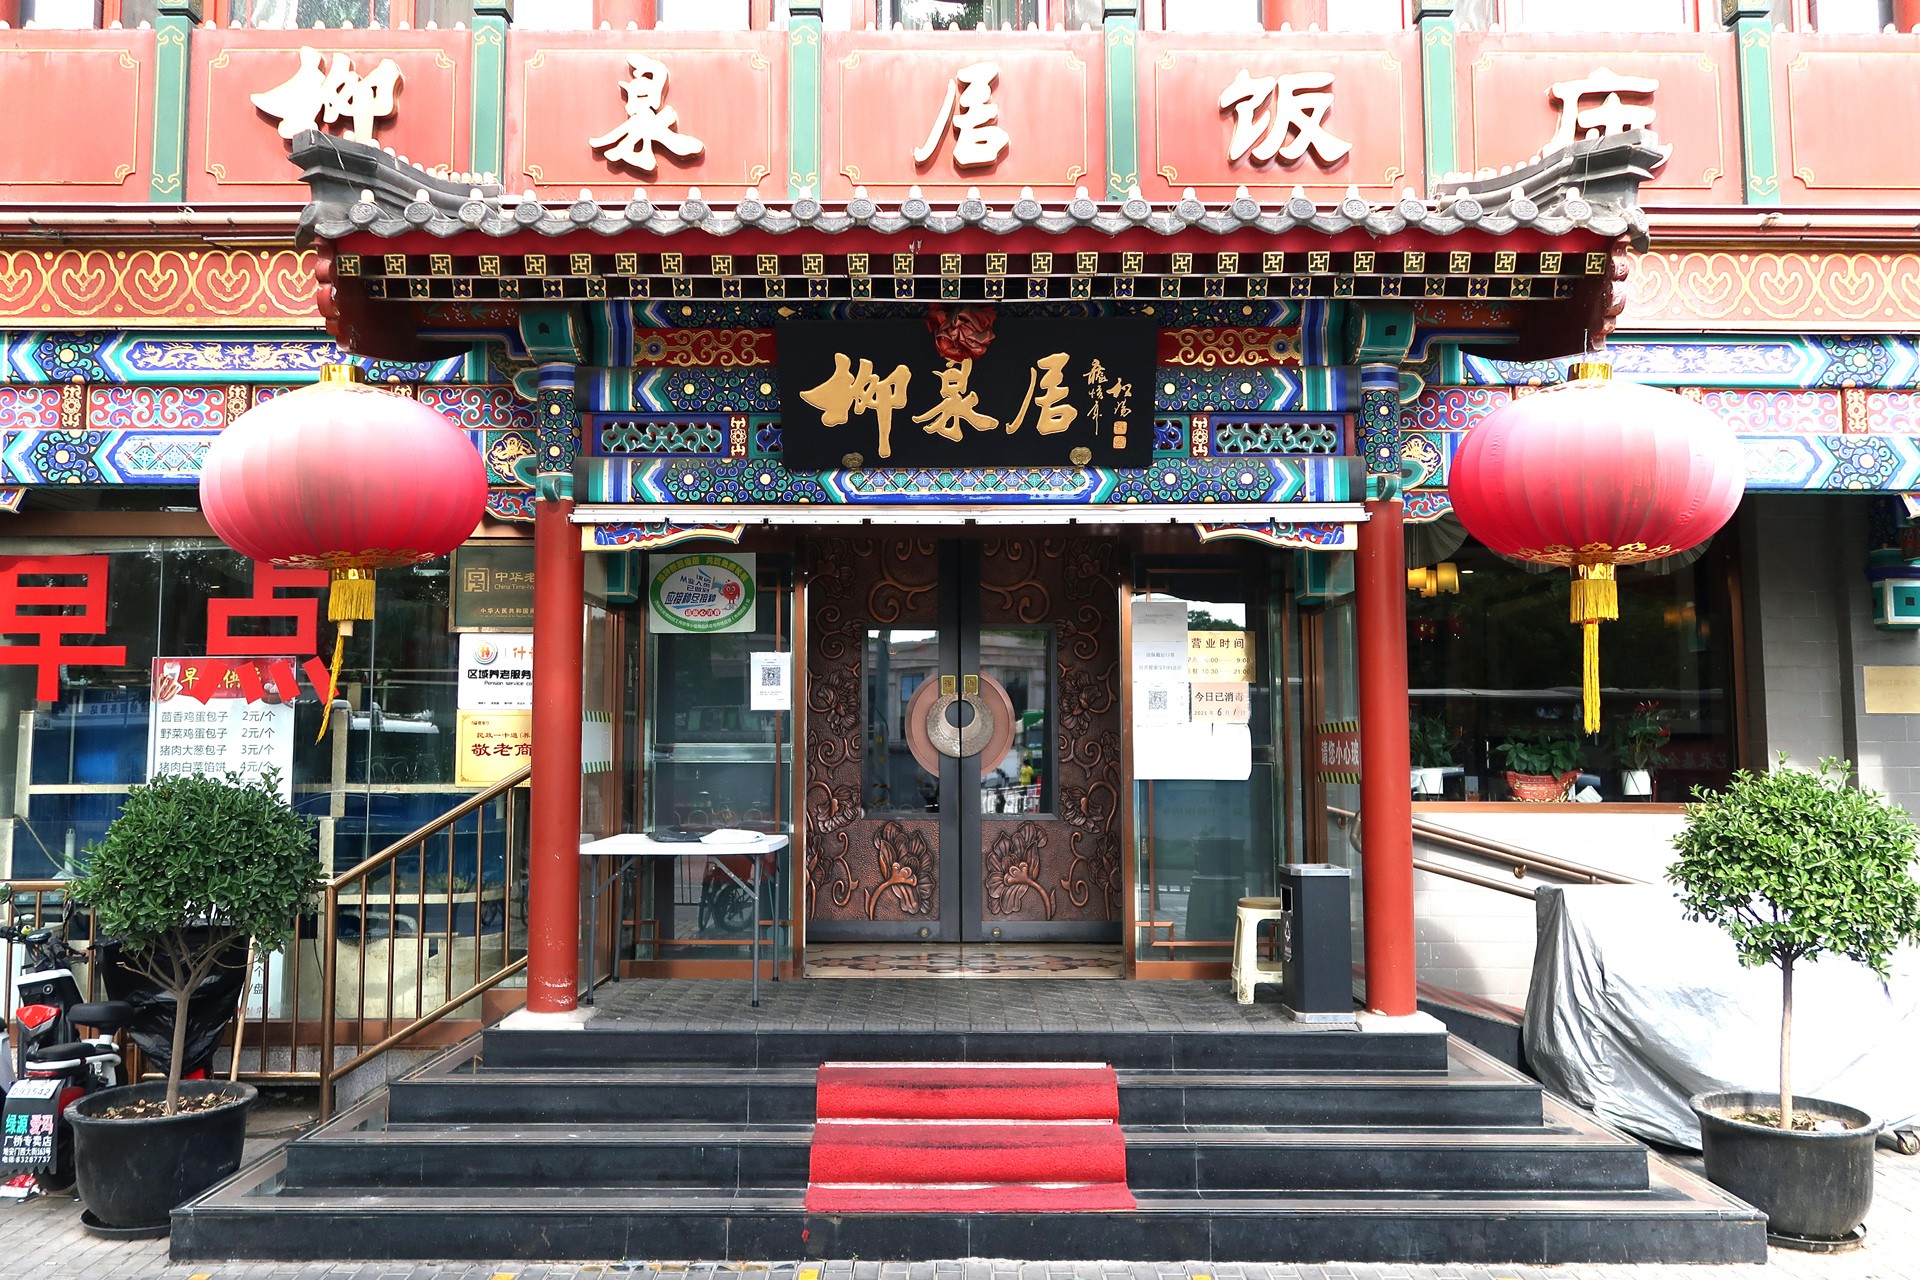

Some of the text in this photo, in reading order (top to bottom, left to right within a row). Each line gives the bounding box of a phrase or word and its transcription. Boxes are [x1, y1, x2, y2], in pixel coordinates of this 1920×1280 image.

[1191, 638, 1245, 649] 营业时间
[1194, 691, 1244, 702] 今日已消毒
[161, 710, 276, 723] 茴香鸡蛋包子 2元/个
[160, 727, 275, 740] 野菜鸡蛋包子 2元/个
[159, 744, 275, 756] 猪肉大葱包子 3元/个
[471, 743, 532, 756] 敬老商
[158, 761, 226, 774] 猪肉白菜馅饼
[5, 1114, 54, 1135] 绿源 爱玛
[3, 1135, 53, 1147] 厂桥专卖店
